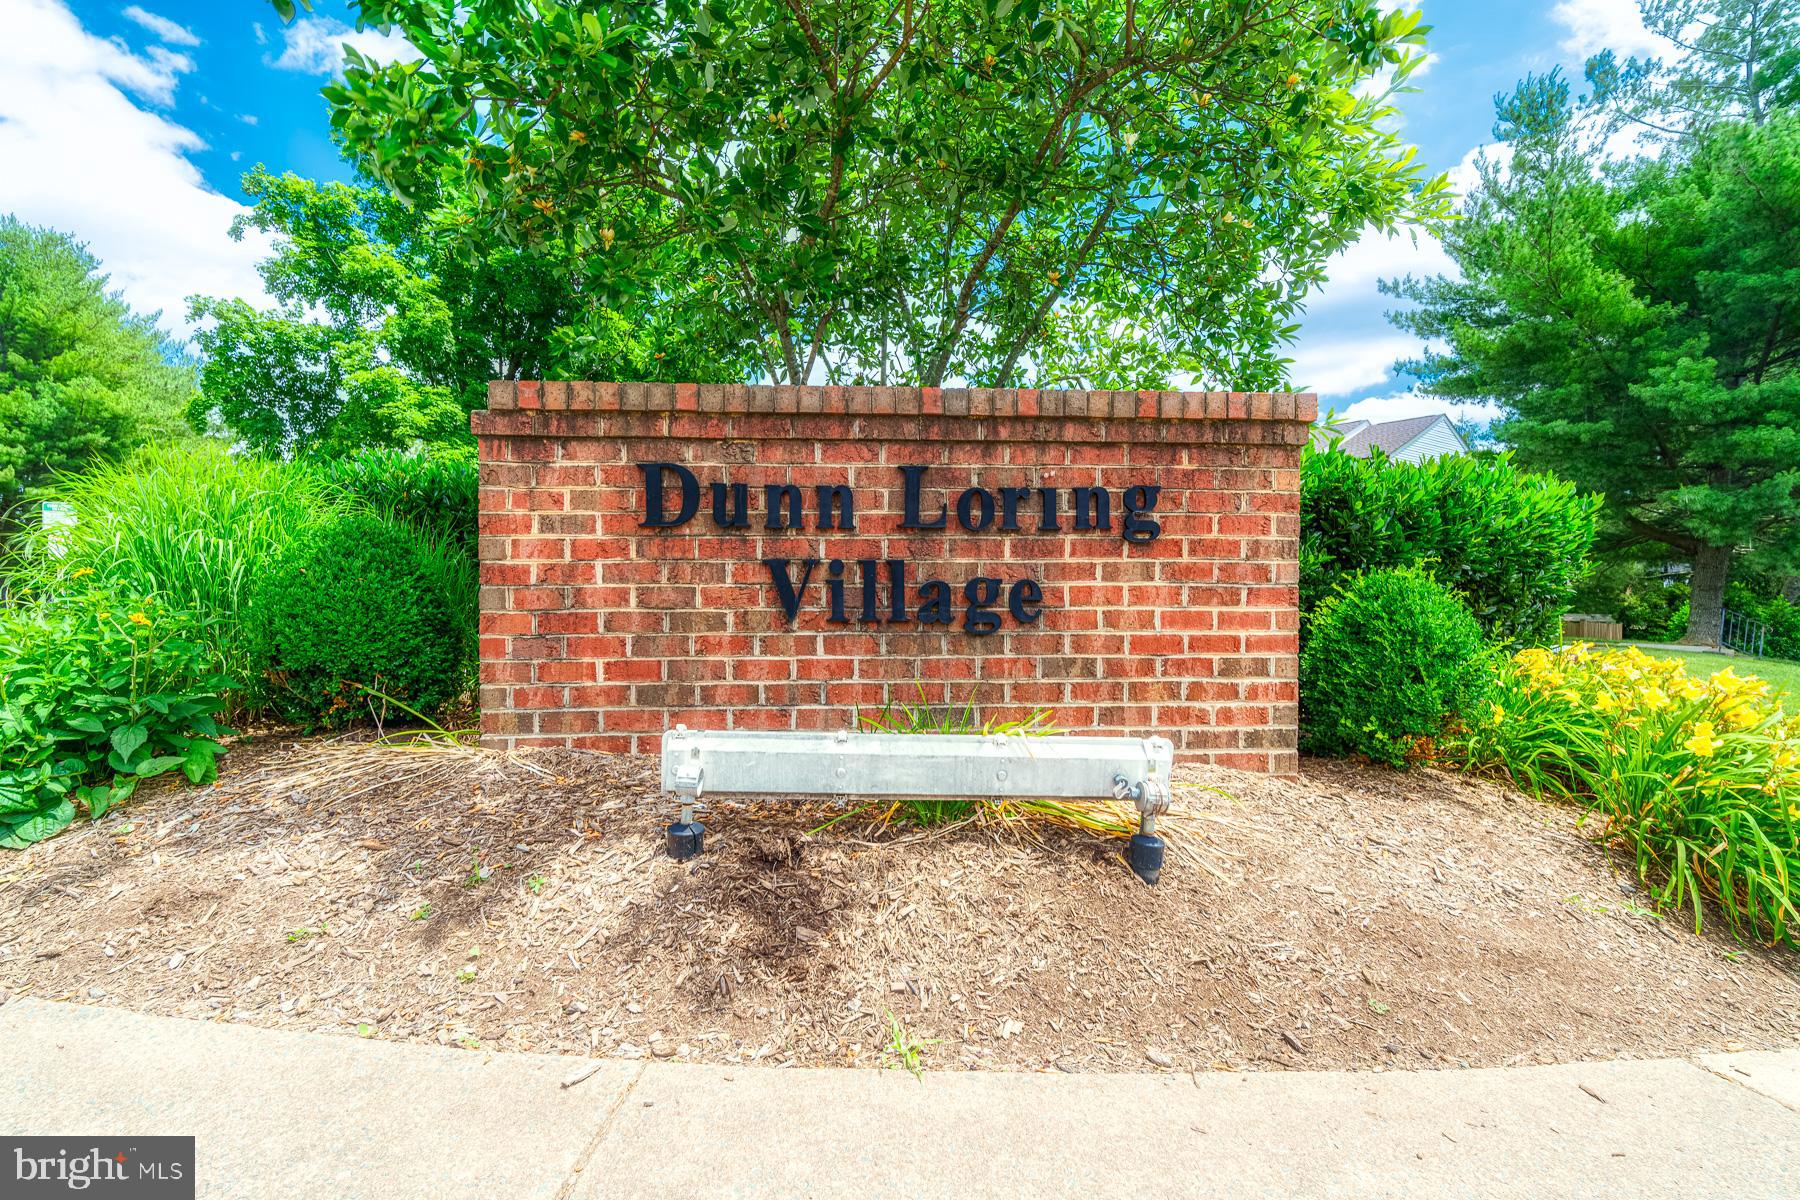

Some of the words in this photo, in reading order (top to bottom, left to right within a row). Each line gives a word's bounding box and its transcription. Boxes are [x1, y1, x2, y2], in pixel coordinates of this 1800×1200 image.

[637, 463, 856, 529] Dunn
[899, 465, 1162, 543] Loring
[762, 558, 1044, 634] Village
